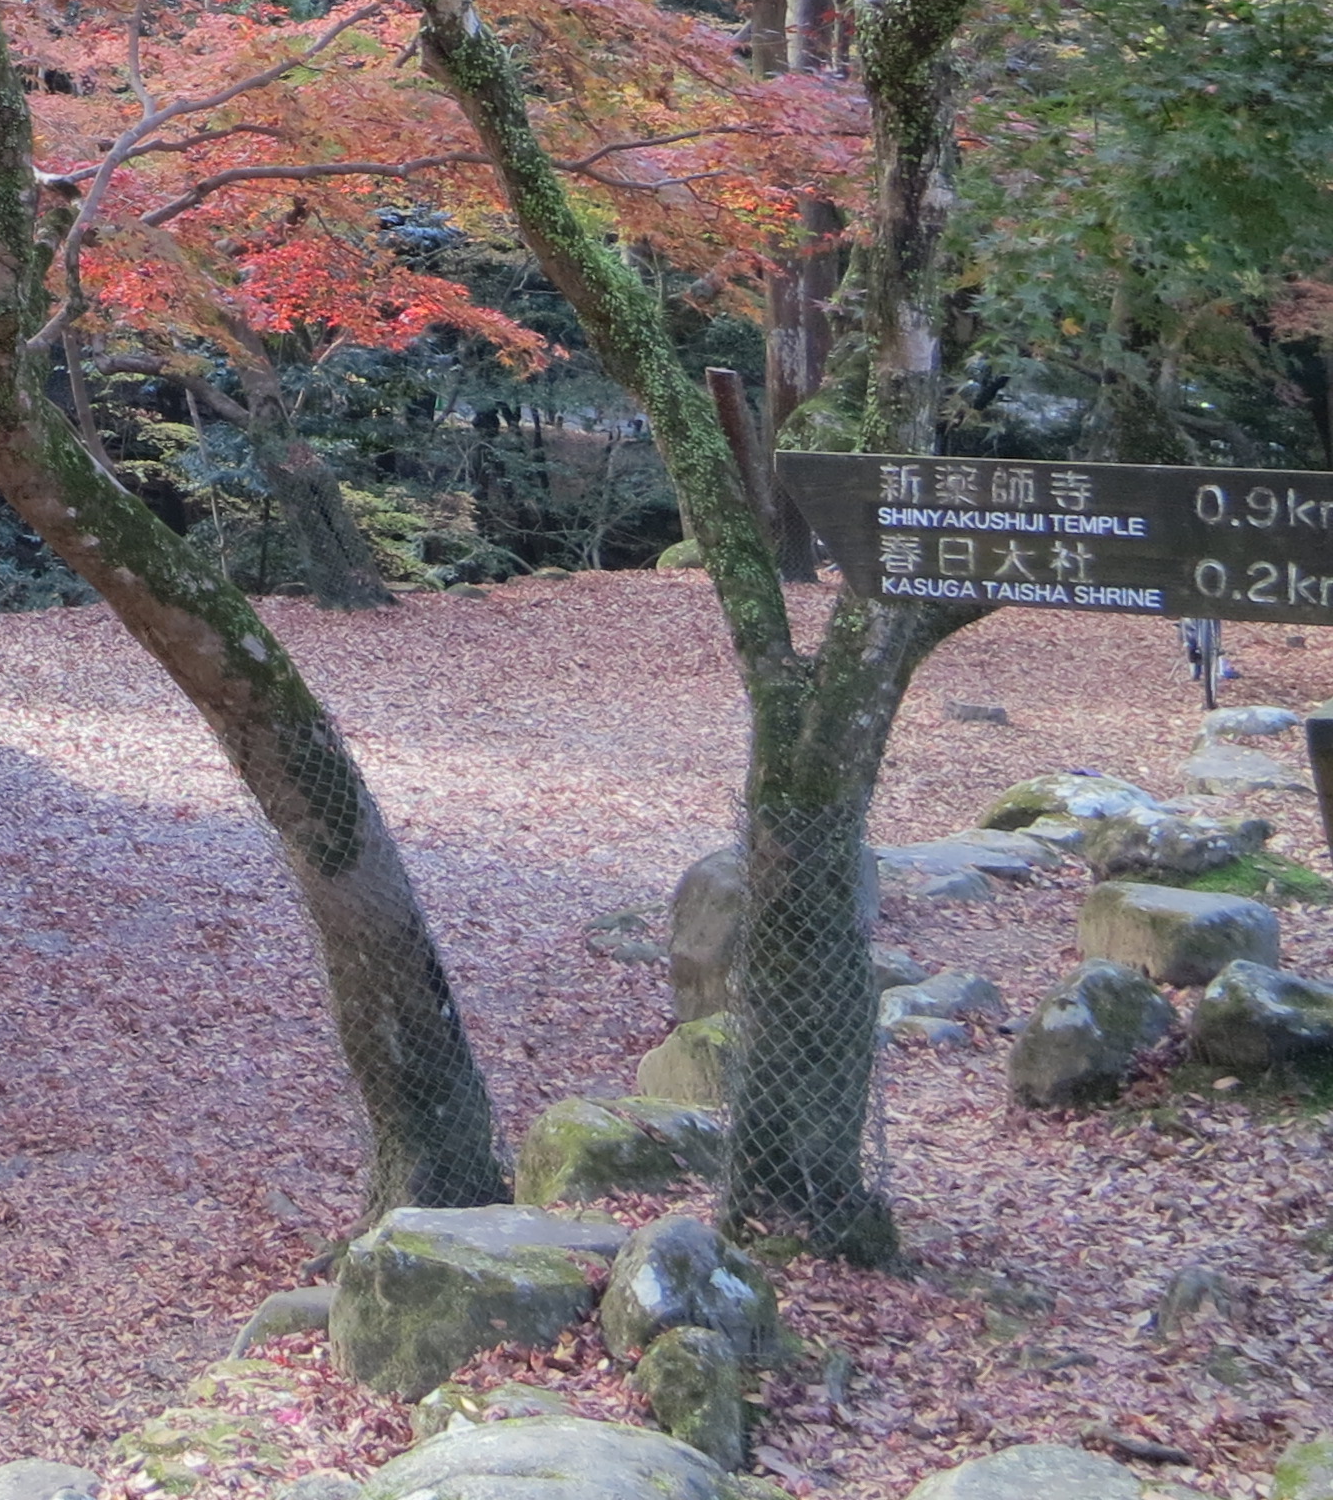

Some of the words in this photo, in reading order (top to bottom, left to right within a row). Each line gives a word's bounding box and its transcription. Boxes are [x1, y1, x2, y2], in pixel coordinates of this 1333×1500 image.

[879, 464, 1093, 511] 新薬師寺
[878, 507, 1044, 531] SHINYAKUSHIJI
[1049, 514, 1146, 536] TEMPLE
[879, 535, 1093, 583] 春日大社
[882, 576, 977, 598] KASUGA
[1074, 586, 1162, 608] SHRINE
